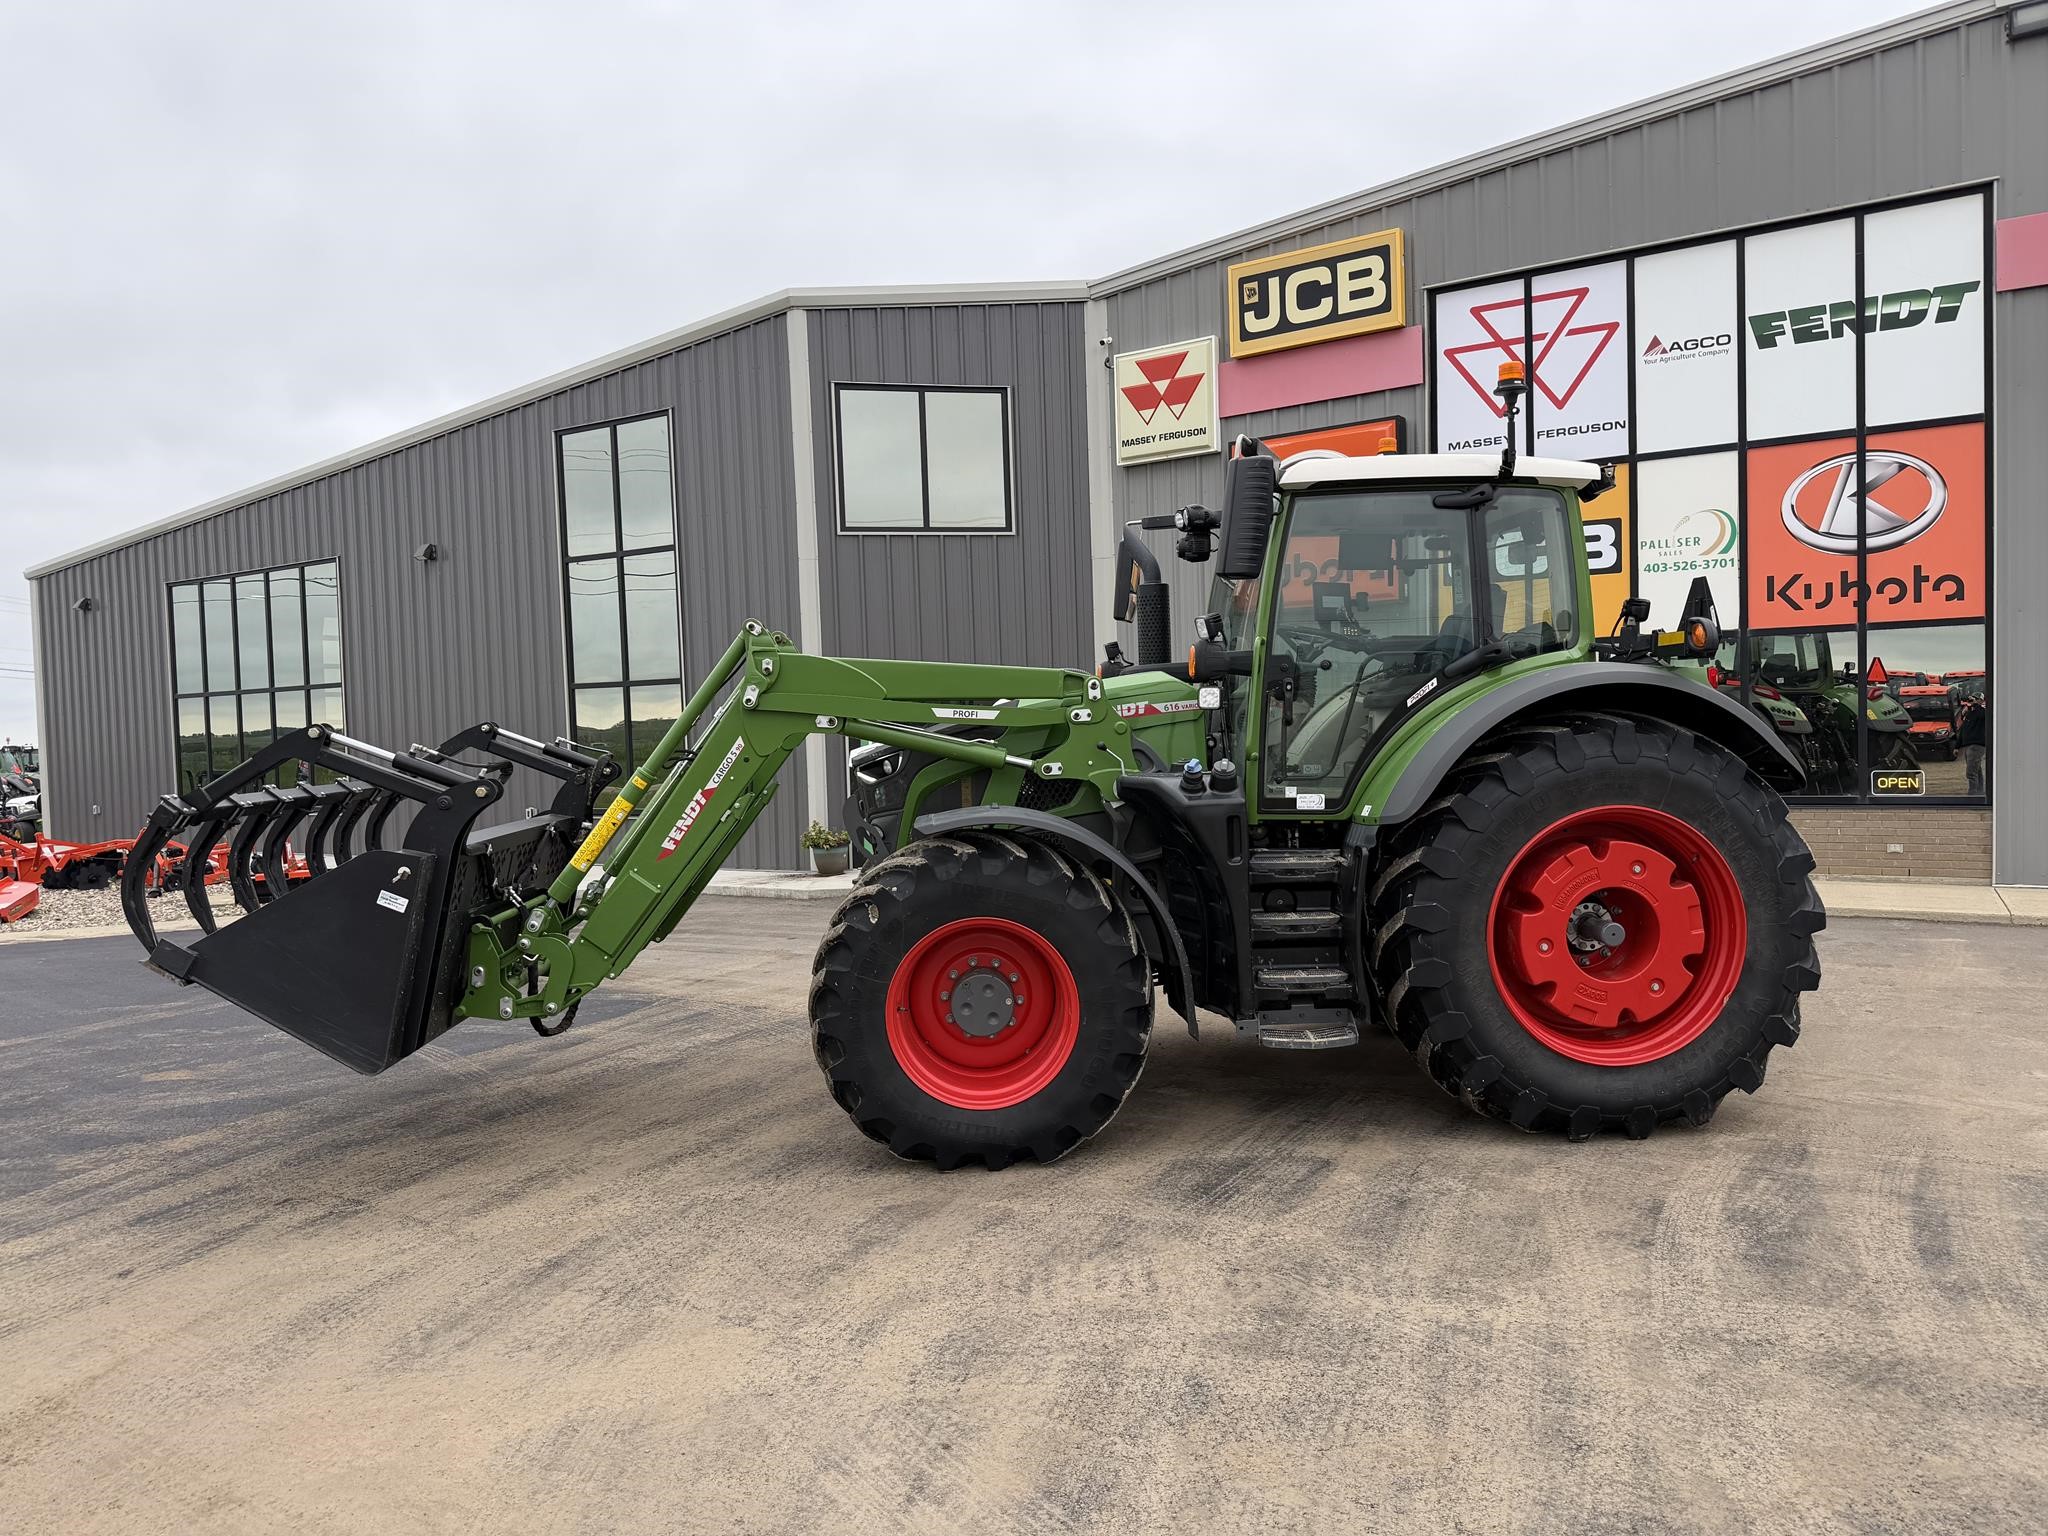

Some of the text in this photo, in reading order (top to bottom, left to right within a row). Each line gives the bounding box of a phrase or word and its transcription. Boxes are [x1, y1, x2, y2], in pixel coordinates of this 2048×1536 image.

[1244, 255, 1387, 333] JCB
[1748, 280, 1981, 350] FENDT
[1669, 334, 1731, 352] AGCO
[1659, 352, 1696, 364] Agriculture
[1698, 347, 1729, 357] Company
[1121, 427, 1207, 448] MASSEY FERGUSON
[1537, 420, 1626, 439] FERGUSON
[1643, 558, 1735, 574] 403-526-3701
[1766, 565, 1965, 611] Kubota
[953, 710, 978, 718] PROFI
[1164, 703, 1180, 711] 616
[1877, 777, 1919, 789] OPEN
[661, 788, 707, 850] FENDT
[712, 756, 734, 784] CARGO
